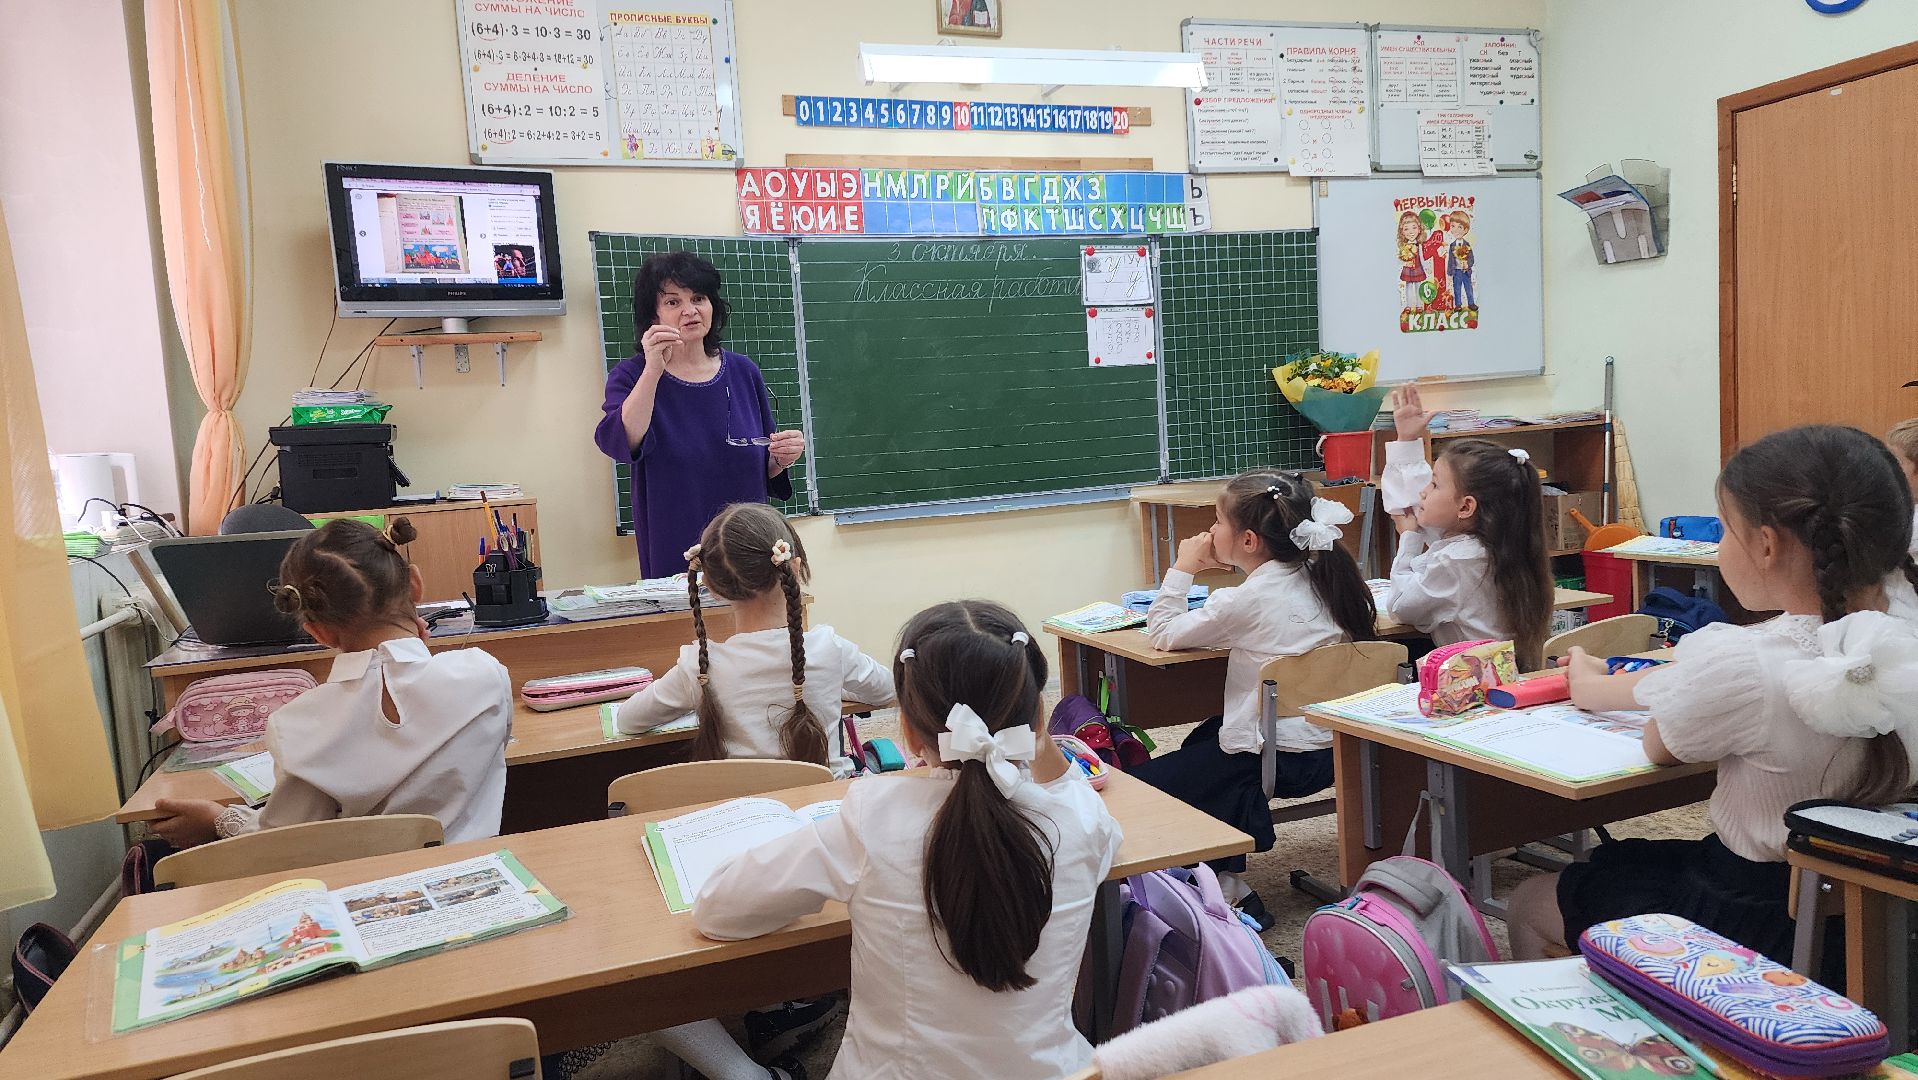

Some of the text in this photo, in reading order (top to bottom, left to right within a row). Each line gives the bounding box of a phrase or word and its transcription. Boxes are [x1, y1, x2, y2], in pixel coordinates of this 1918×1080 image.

[474, 2, 522, 13] СУММЫ
[525, 6, 541, 15] НА
[545, 7, 585, 18] ЧИСЛО
[609, 13, 708, 25] ПРОПИСНЫЕ БУКВЫ
[576, 28, 591, 40] 30
[1203, 37, 1263, 47] ЧАСТИ РЕЧИ
[1286, 47, 1357, 56] ПРАВИЛА КОРНЯ
[583, 54, 594, 65] 30
[506, 72, 566, 83] ДЕЛЕНИЕ
[483, 82, 593, 94] СУММЫ НА ЧИСЛО
[592, 106, 599, 118] 5
[800, 101, 1129, 130] 0 1 2 3 4 5 6 7 8 9 10 11 12 13 14 15 16 17 18 19 20
[595, 131, 600, 141] 5
[887, 242, 901, 261] 3
[854, 260, 987, 303] Классная
[1408, 310, 1470, 331] КЛАСС
